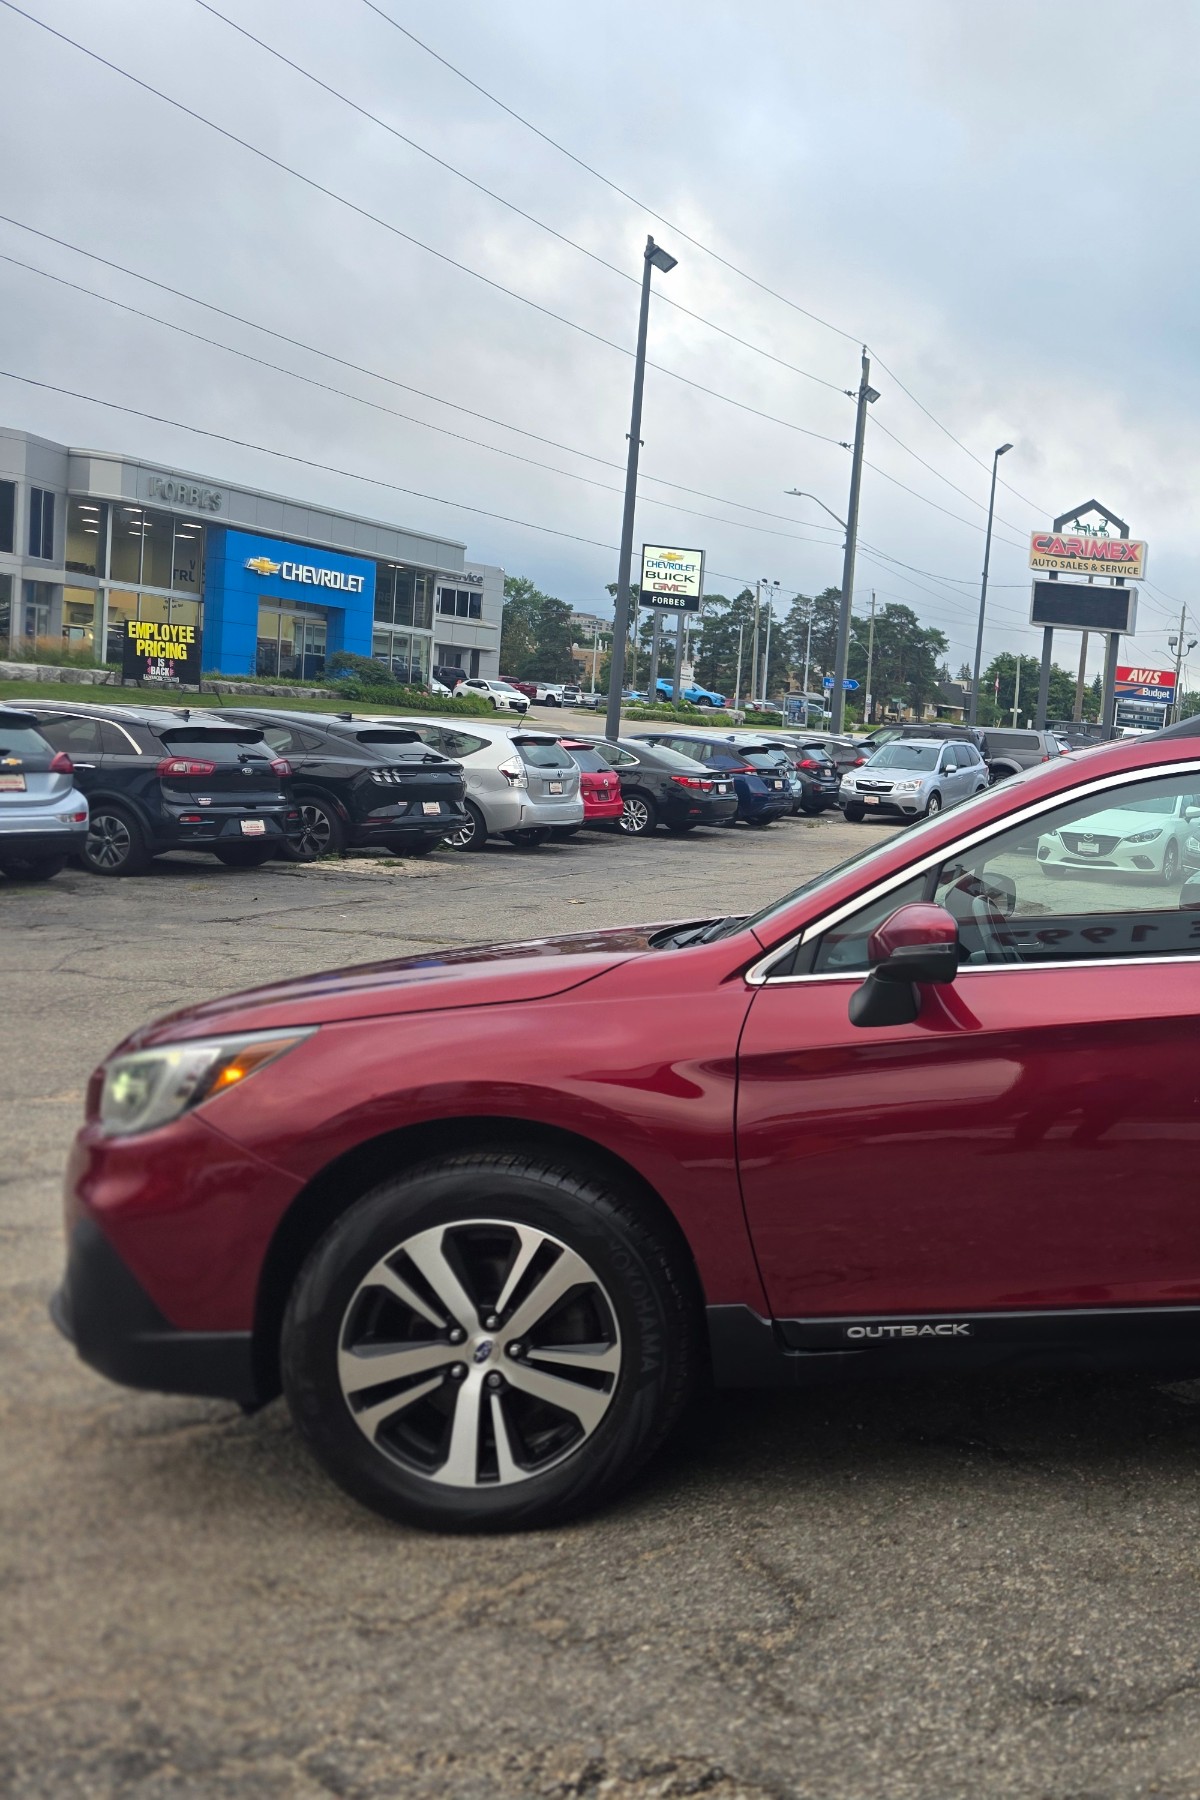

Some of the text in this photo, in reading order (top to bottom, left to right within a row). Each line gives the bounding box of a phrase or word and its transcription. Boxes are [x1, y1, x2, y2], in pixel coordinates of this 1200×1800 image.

[148, 476, 222, 512] FORBES
[1031, 534, 1140, 562] CARIMEX
[646, 560, 696, 572] CHEVROLET
[1031, 558, 1139, 575] AUTO SALES & SERVICE
[282, 561, 364, 592] CHEVROLET
[645, 570, 695, 583] BUICK
[653, 582, 687, 593] GMC
[652, 596, 686, 607] FORBES
[127, 621, 196, 644] EMPLOYEE
[136, 639, 188, 660] PRICING
[157, 657, 165, 668] IS
[150, 665, 170, 677] BACK
[1127, 669, 1162, 685] AVIS
[1142, 687, 1170, 699] Budget
[846, 1323, 970, 1339] OUTBACK
